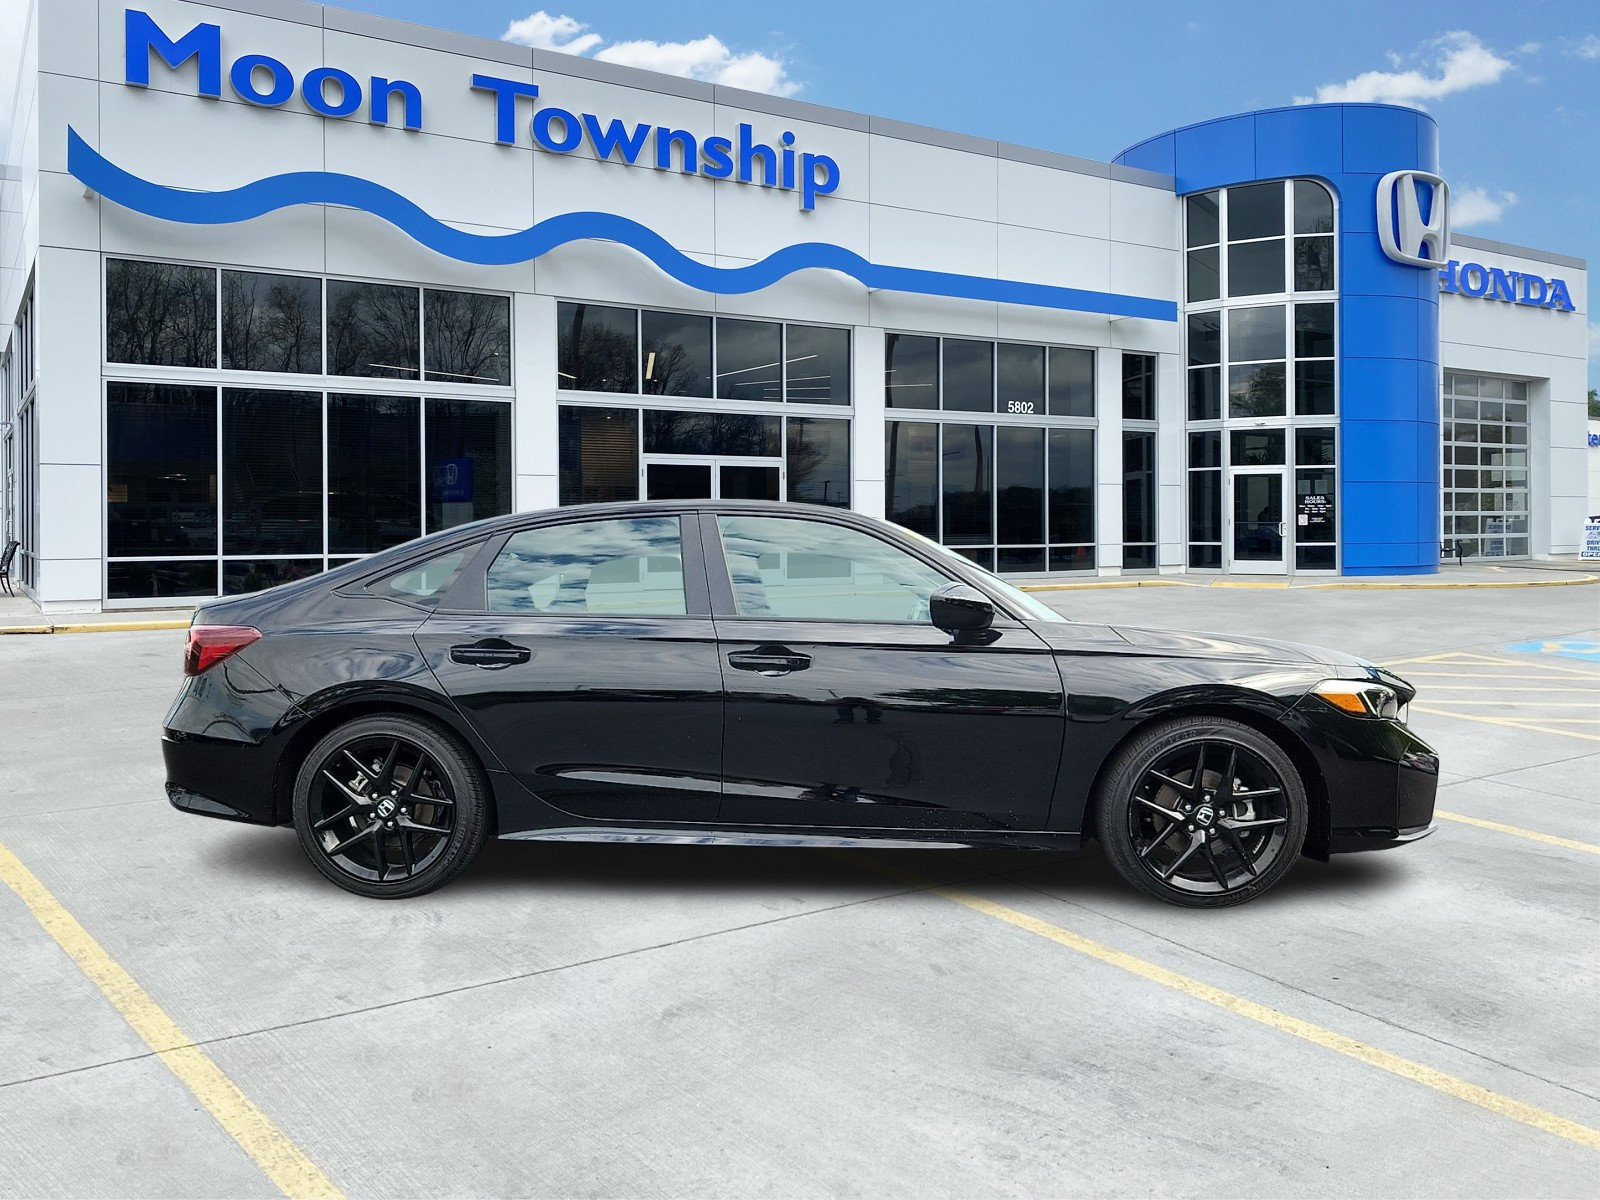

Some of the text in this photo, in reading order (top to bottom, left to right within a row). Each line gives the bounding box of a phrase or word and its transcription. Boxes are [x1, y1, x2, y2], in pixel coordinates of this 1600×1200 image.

[125, 9, 840, 212] Moon Township
[1438, 259, 1576, 312] HONDA
[1007, 400, 1034, 414] 5802
